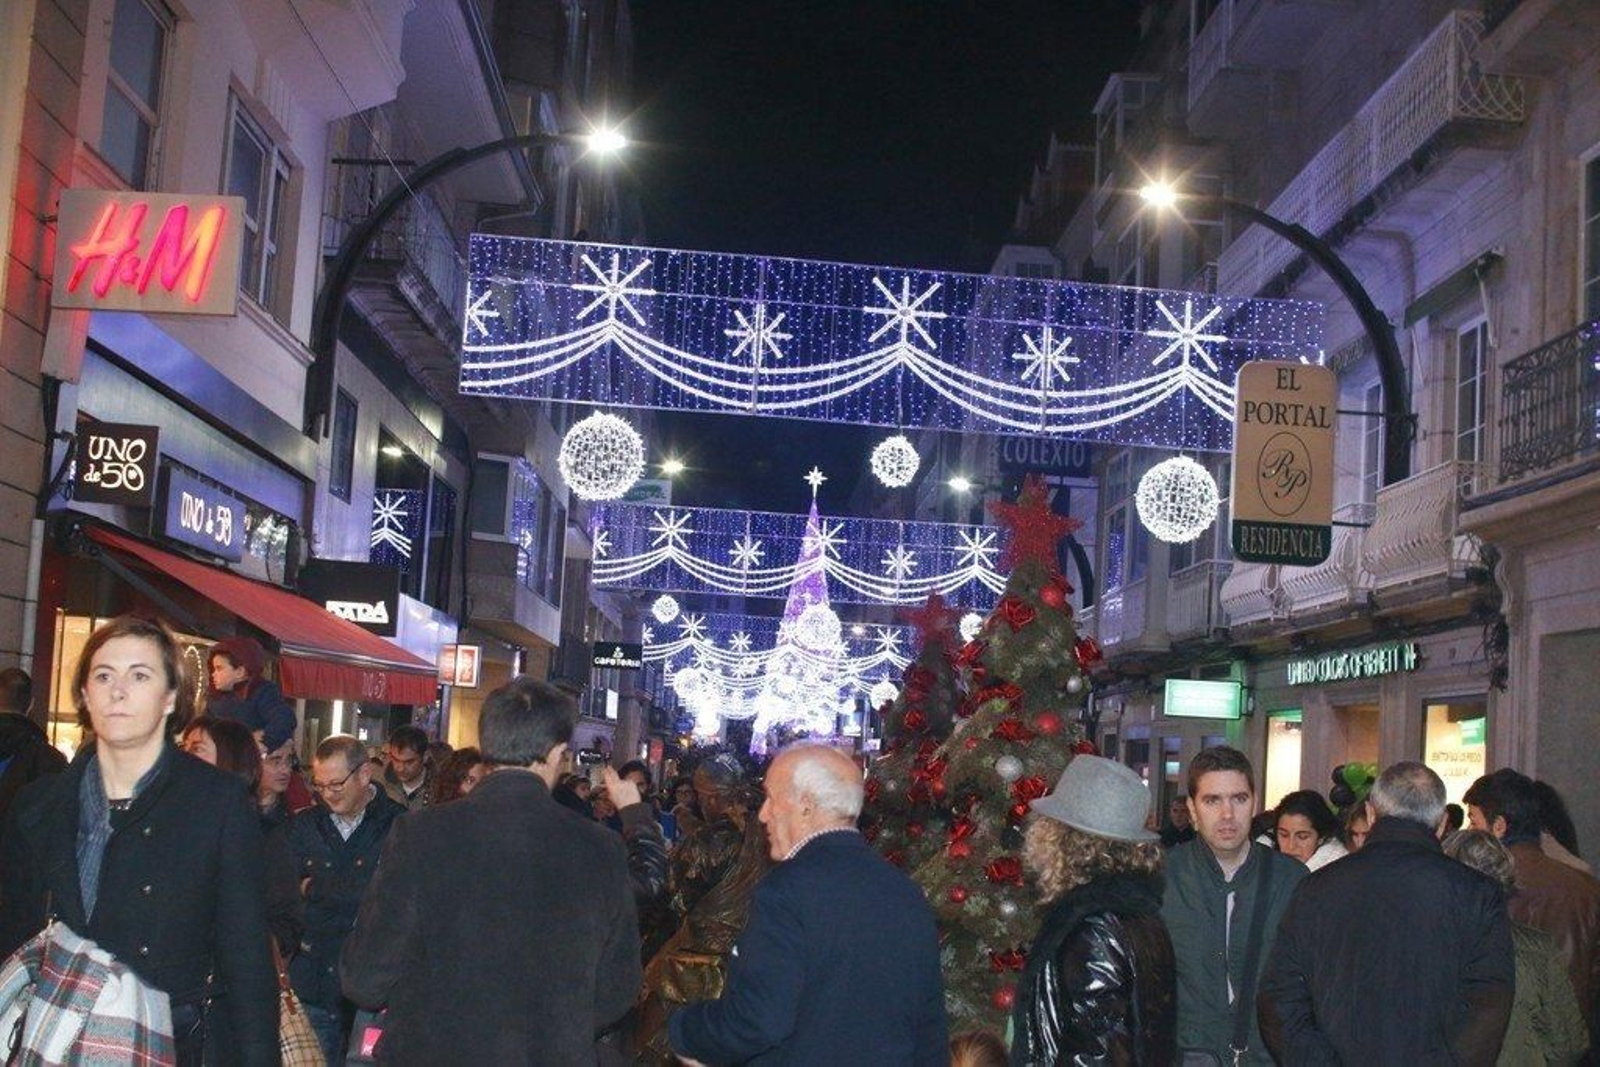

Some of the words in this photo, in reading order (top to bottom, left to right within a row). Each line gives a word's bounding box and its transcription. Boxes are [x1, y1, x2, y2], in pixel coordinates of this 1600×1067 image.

[67, 202, 225, 302] H&M
[1276, 367, 1302, 391] EL
[1243, 400, 1331, 429] PORTAL
[88, 435, 147, 463] UNO
[1003, 437, 1085, 468] COLEXIO
[83, 463, 101, 483] de
[101, 461, 145, 491] 50
[1240, 526, 1324, 558] RESIDENCIA
[1363, 642, 1417, 677] BENETTN
